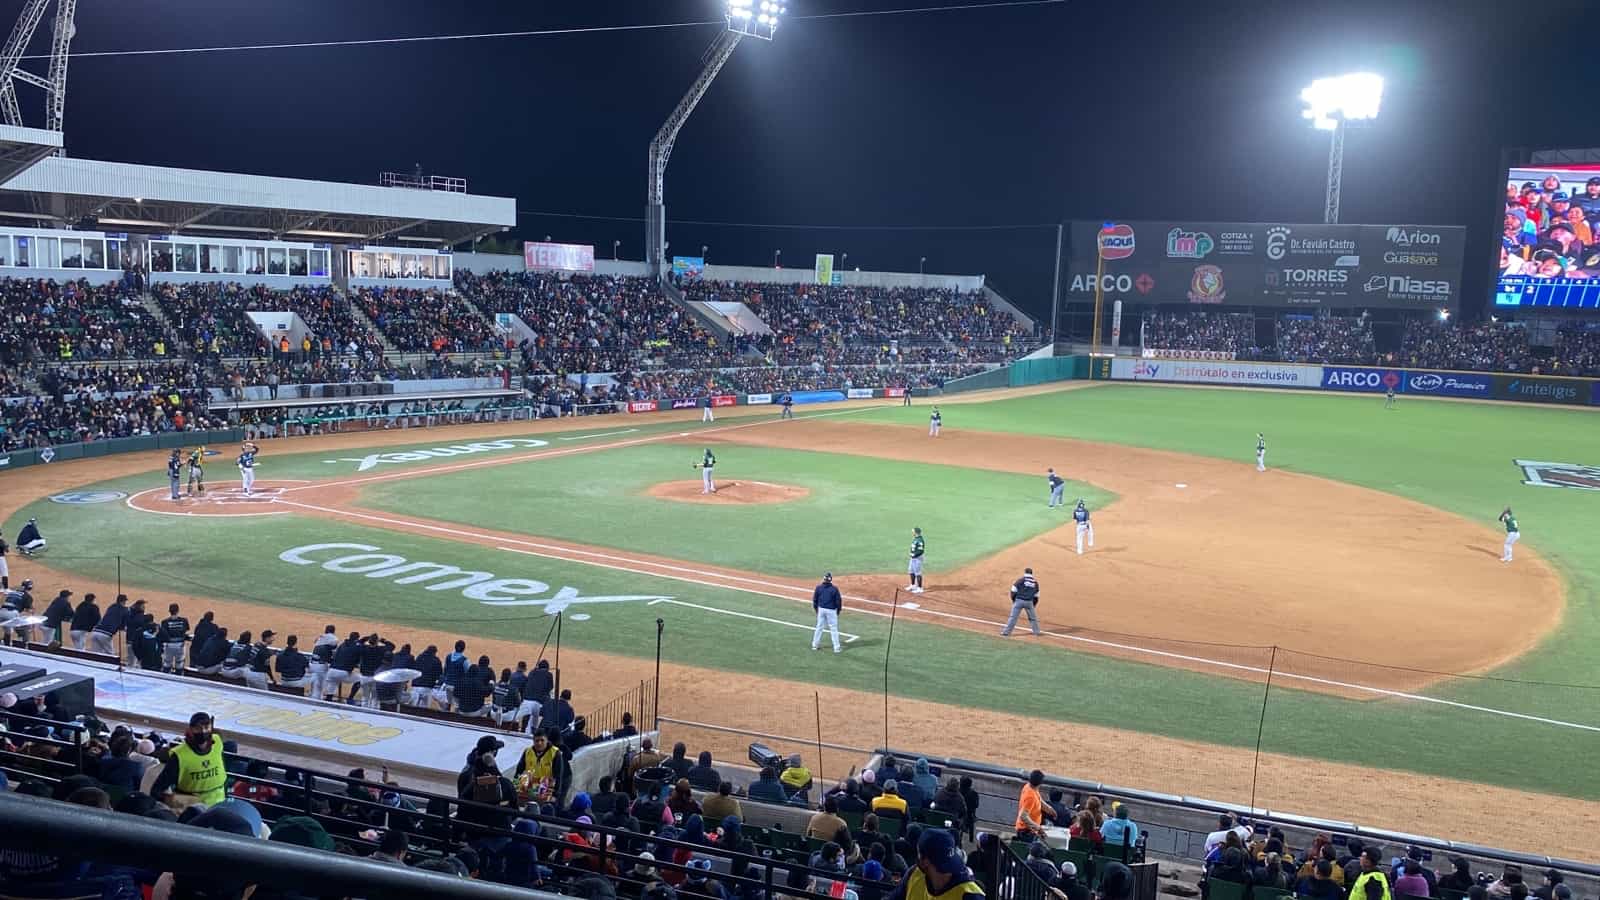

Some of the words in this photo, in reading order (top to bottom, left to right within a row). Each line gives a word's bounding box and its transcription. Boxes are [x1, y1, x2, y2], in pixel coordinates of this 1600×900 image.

[1283, 269, 1349, 282] TORRES
[1070, 274, 1132, 292] ARCO
[1134, 362, 1160, 378] sky
[1231, 371, 1245, 379] en
[1247, 370, 1298, 381] exclusiva
[1327, 372, 1380, 386] ARCO
[279, 542, 676, 616] Comex
[190, 766, 219, 780] TECATE
